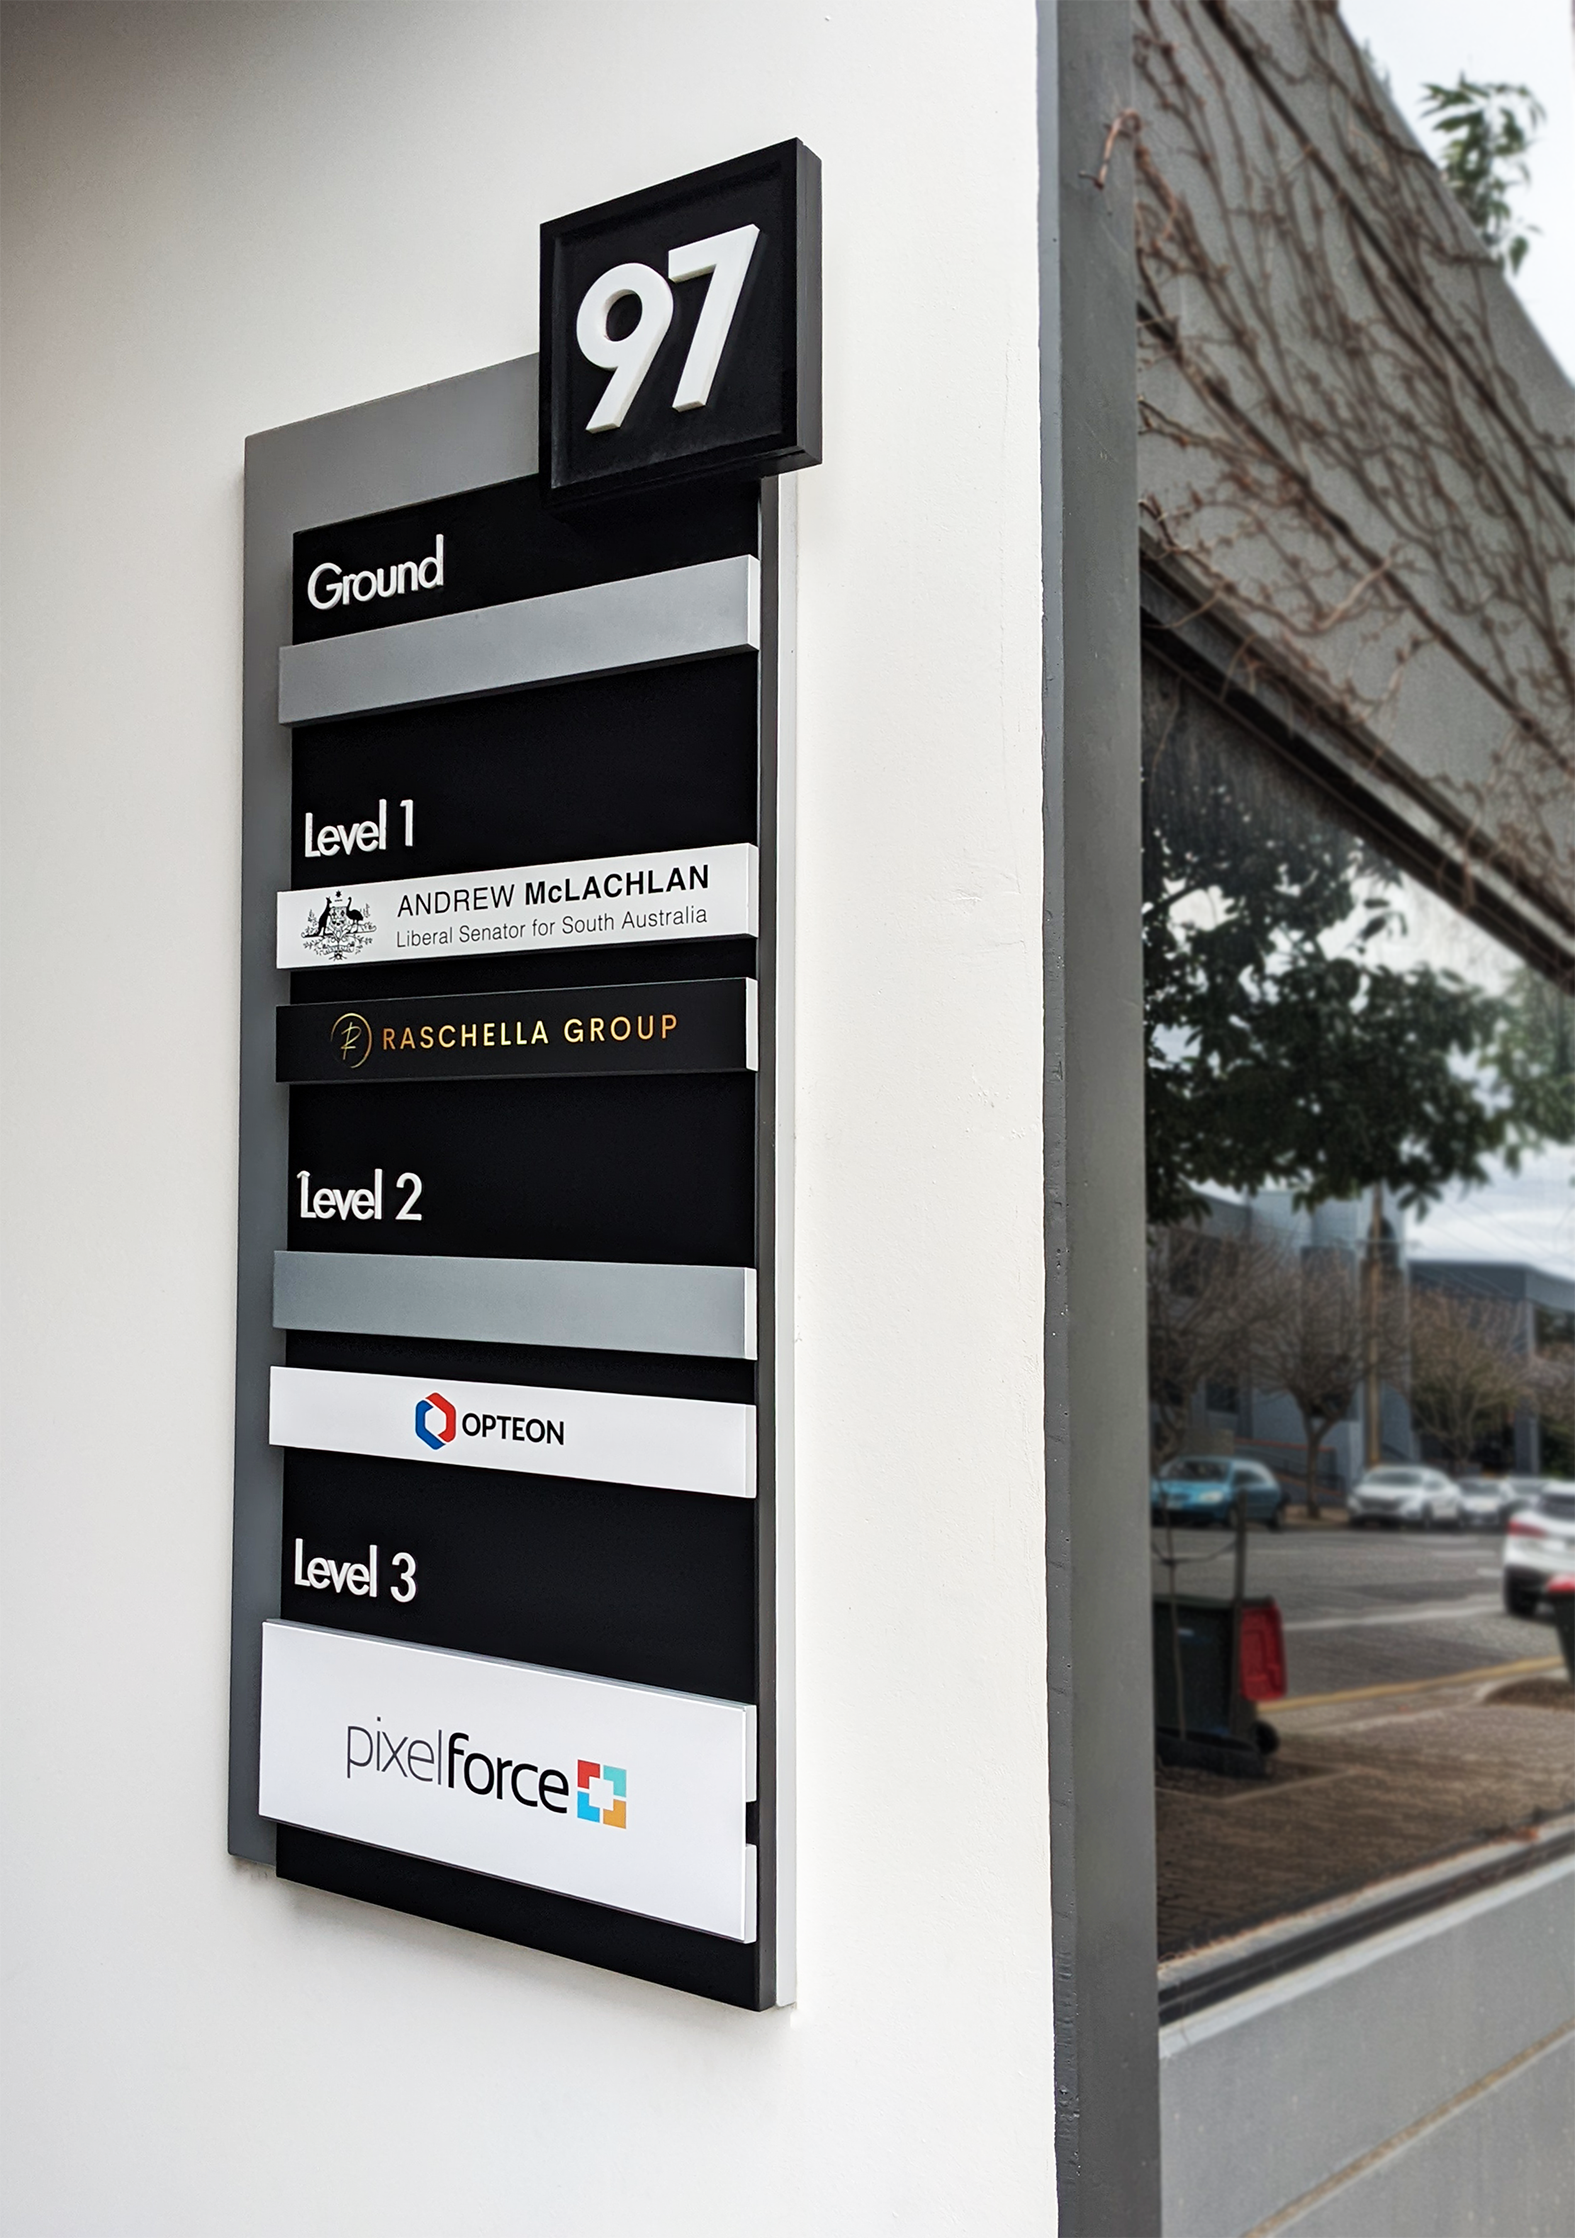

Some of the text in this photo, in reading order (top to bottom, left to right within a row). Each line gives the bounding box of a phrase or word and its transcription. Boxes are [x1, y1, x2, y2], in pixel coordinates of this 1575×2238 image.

[576, 223, 761, 434] 97
[307, 533, 445, 611] Ground
[304, 798, 414, 858] Level 1
[397, 864, 709, 918] ANDREW McLACHLAN
[396, 905, 708, 948] Liberal Senator for South Australia
[382, 1013, 679, 1051] RASCHELLA GROUP
[297, 1168, 424, 1221] Level 2
[461, 1412, 565, 1447] OPTEON
[294, 1538, 417, 1604] Level 3
[346, 1716, 570, 1814] pixelforce
